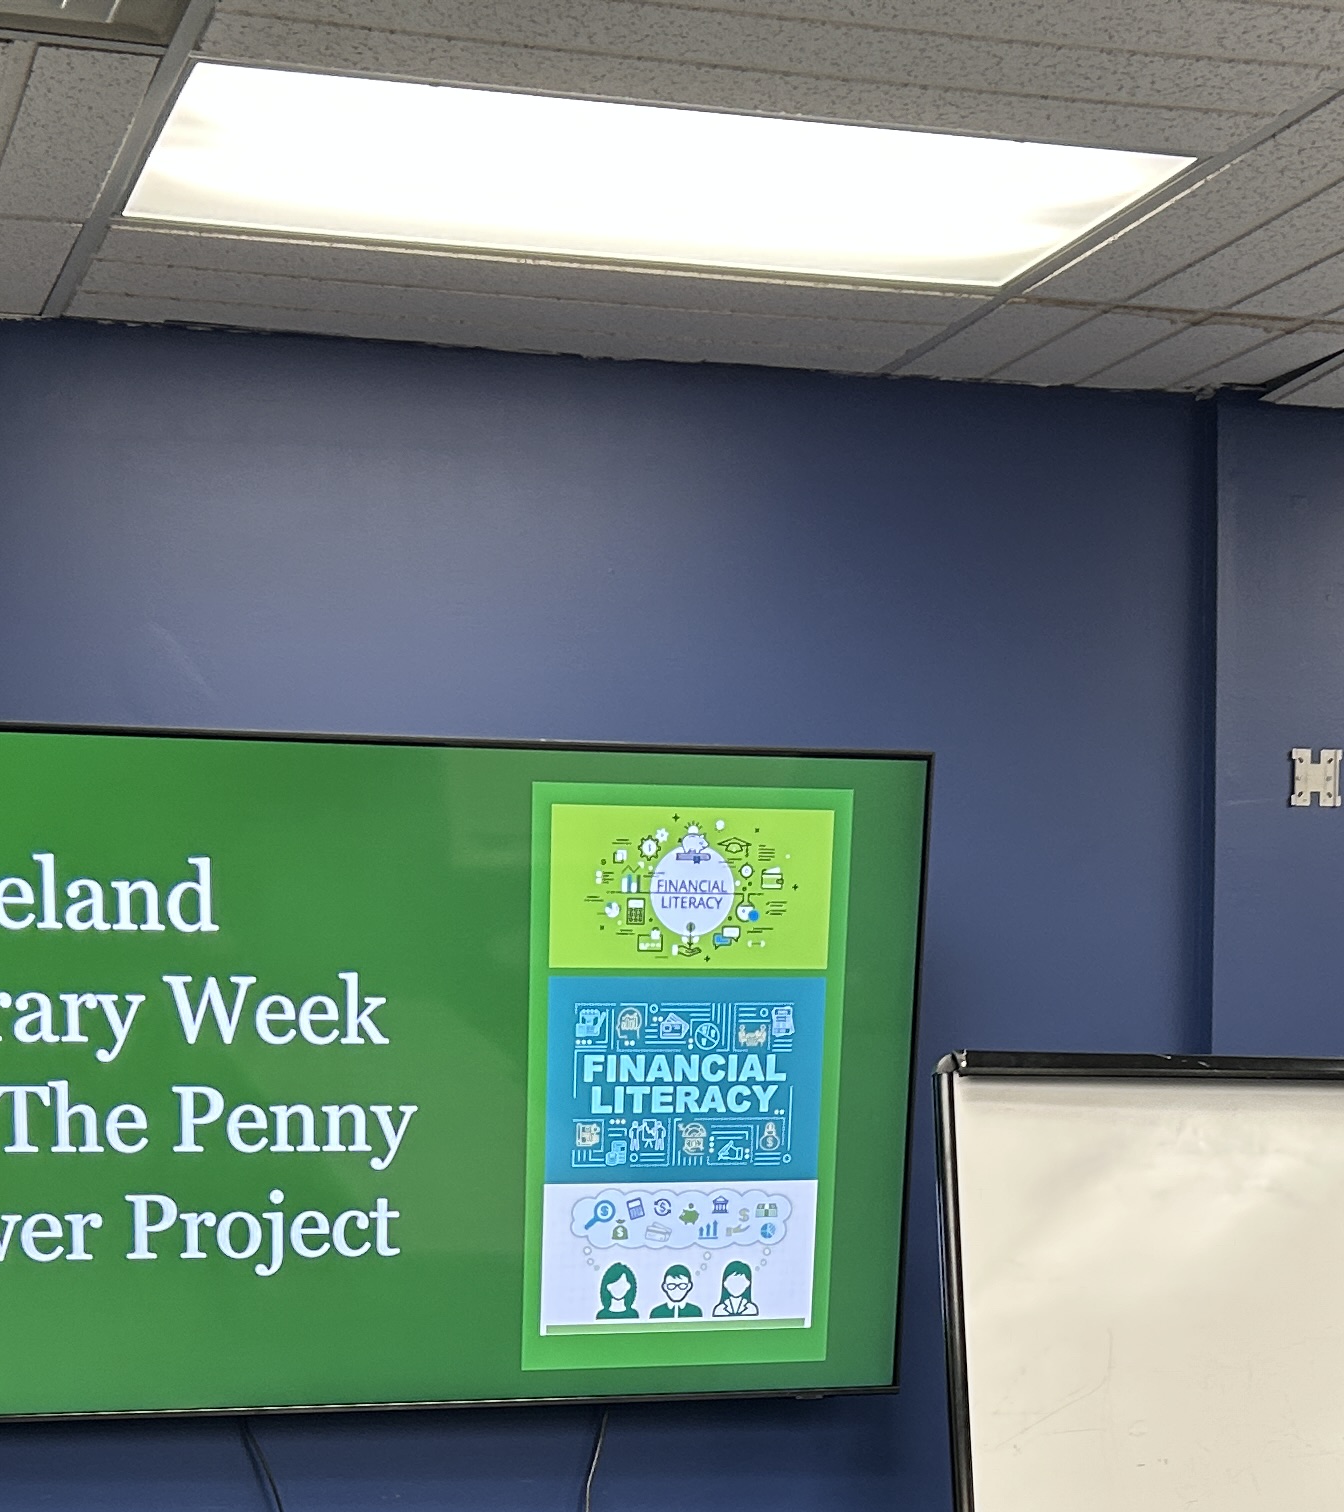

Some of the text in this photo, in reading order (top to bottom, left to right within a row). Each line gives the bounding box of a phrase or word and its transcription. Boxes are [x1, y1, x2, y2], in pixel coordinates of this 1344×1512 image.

[656, 879, 728, 894] FINANCIAL
[660, 896, 724, 910] LITERACY
[161, 971, 390, 1046] Week
[583, 1053, 787, 1083] FINANCIAL
[590, 1084, 779, 1115] LITERACY
[171, 1085, 419, 1171] Penny
[124, 1189, 401, 1277] Project
